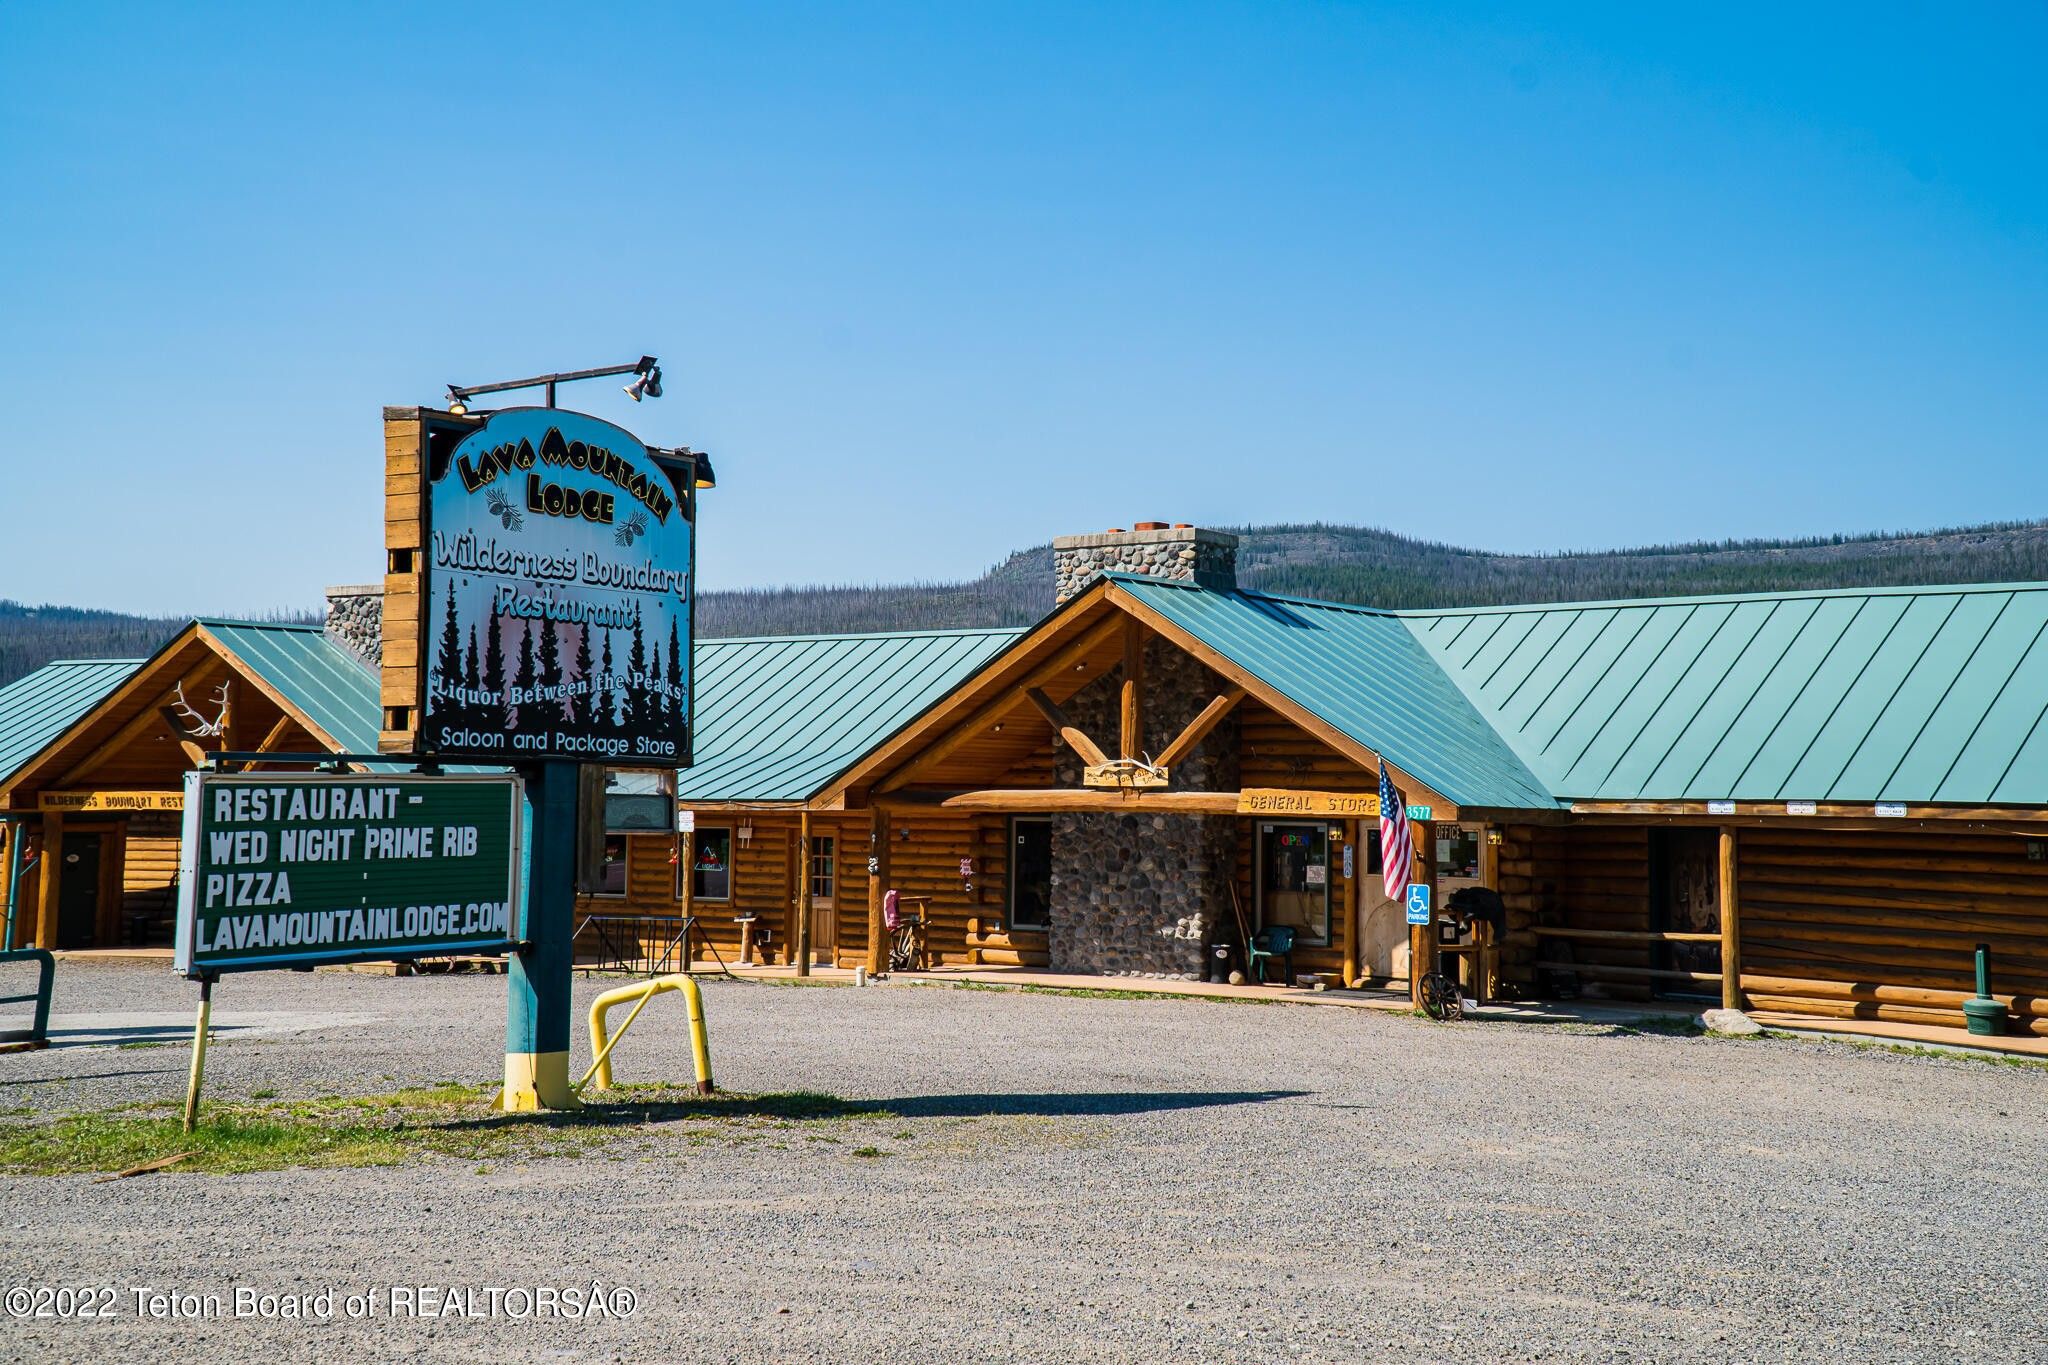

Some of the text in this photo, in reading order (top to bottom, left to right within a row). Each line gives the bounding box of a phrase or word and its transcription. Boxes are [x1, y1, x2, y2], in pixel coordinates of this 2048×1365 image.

[458, 426, 673, 525] LAVA MOUNTAIN
[528, 472, 615, 524] LODGE
[433, 529, 688, 603] Wilderness Boundary
[496, 583, 636, 629] Restaurant
[510, 680, 588, 706] Between
[595, 672, 626, 692] the
[441, 726, 675, 757] Saloon and Package Store
[214, 788, 400, 822] RESTAURANT
[1249, 795, 1377, 812] GENERAL STORE
[1406, 806, 1431, 819] 3577
[209, 826, 478, 865] WED NIGHT PRIME RIB
[1281, 833, 1310, 847] OPEN
[1435, 825, 1461, 840] OFFICE
[205, 872, 291, 908] PIZZA
[195, 902, 509, 952] LAVAMOUNTAINLODGE.COM
[1408, 913, 1429, 921] PARKING
